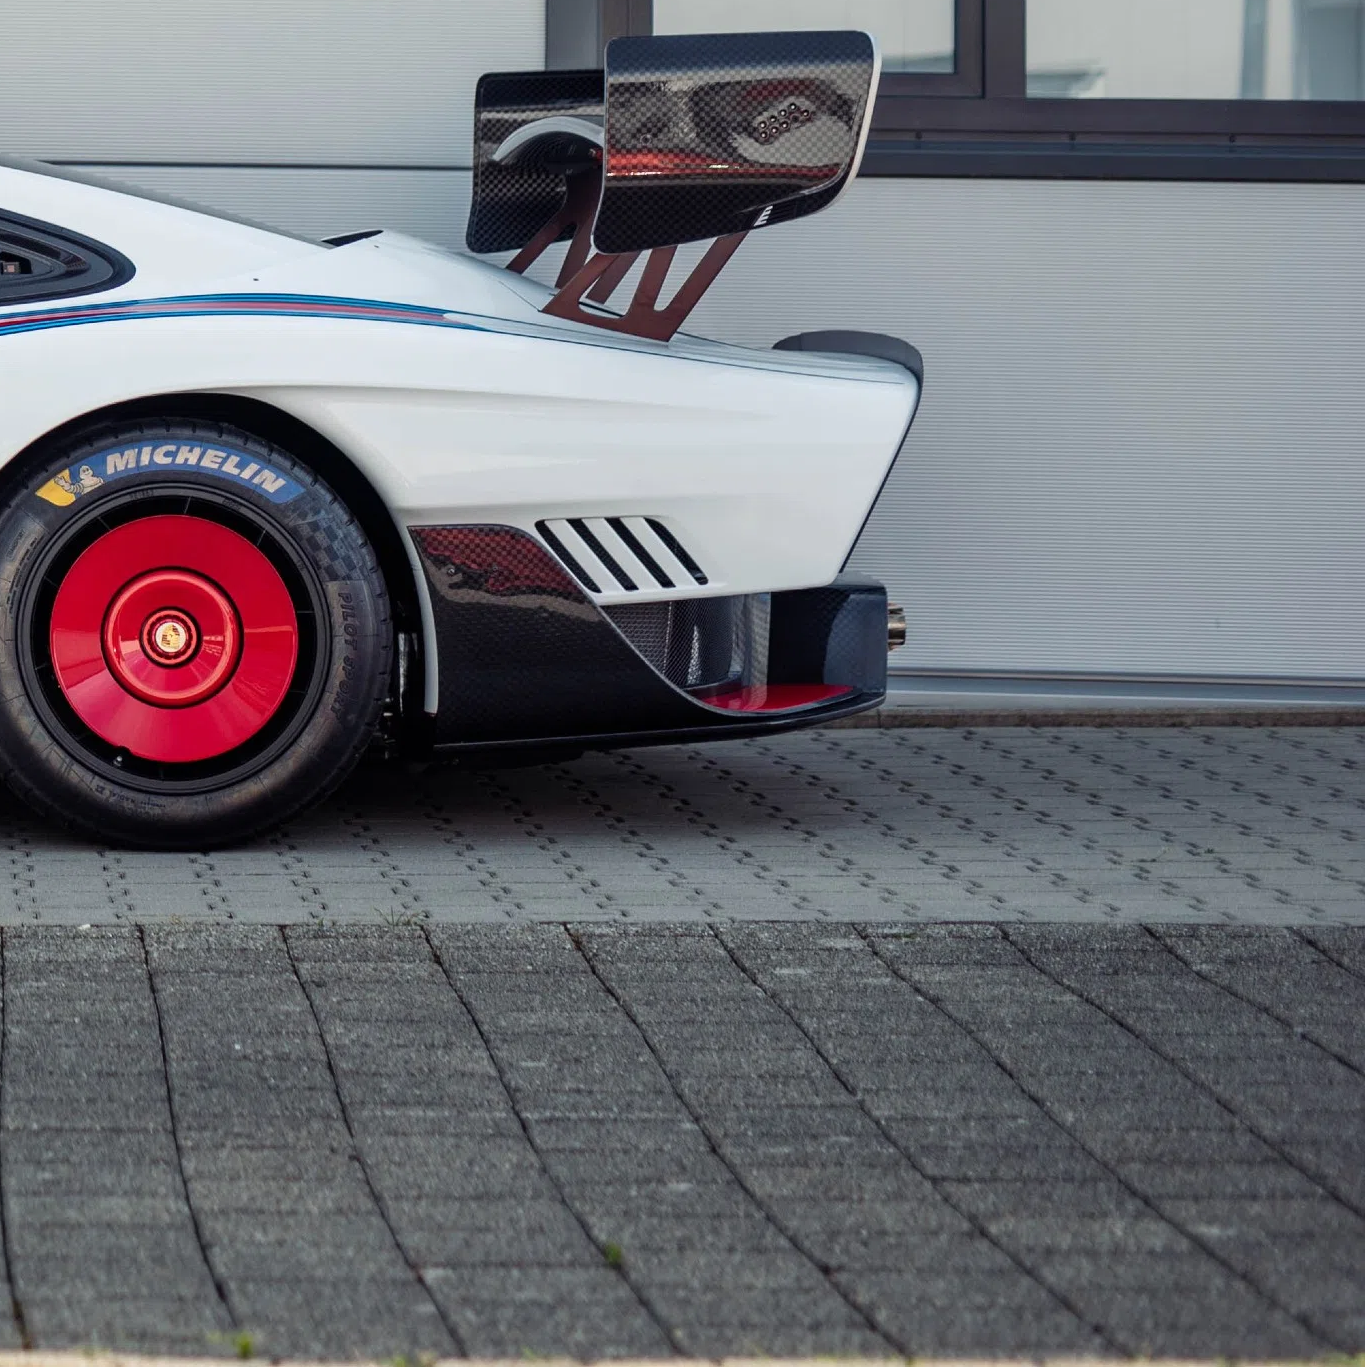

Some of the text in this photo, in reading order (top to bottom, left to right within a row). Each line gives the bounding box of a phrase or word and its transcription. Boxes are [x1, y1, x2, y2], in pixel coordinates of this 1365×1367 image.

[106, 445, 287, 494] MICHELIN
[330, 592, 358, 720] PILOT SPORT
